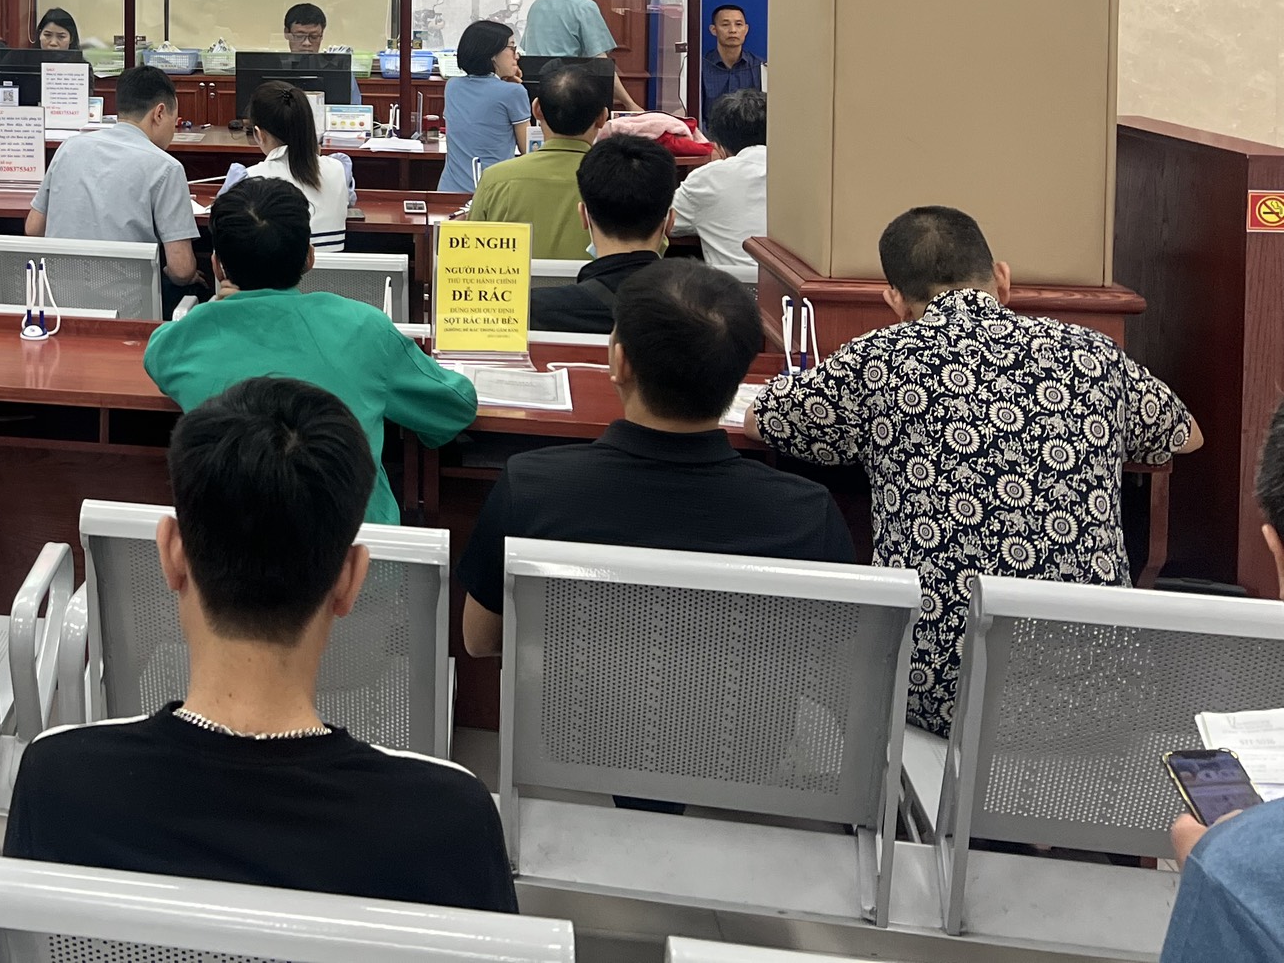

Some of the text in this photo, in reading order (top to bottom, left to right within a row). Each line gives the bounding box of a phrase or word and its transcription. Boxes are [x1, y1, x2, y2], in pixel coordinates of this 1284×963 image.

[449, 234, 516, 252] ĐỀ NGHỊ
[445, 266, 520, 274] NGƯỜI DÂN LÀM
[452, 287, 512, 302] ĐỂ RÁC
